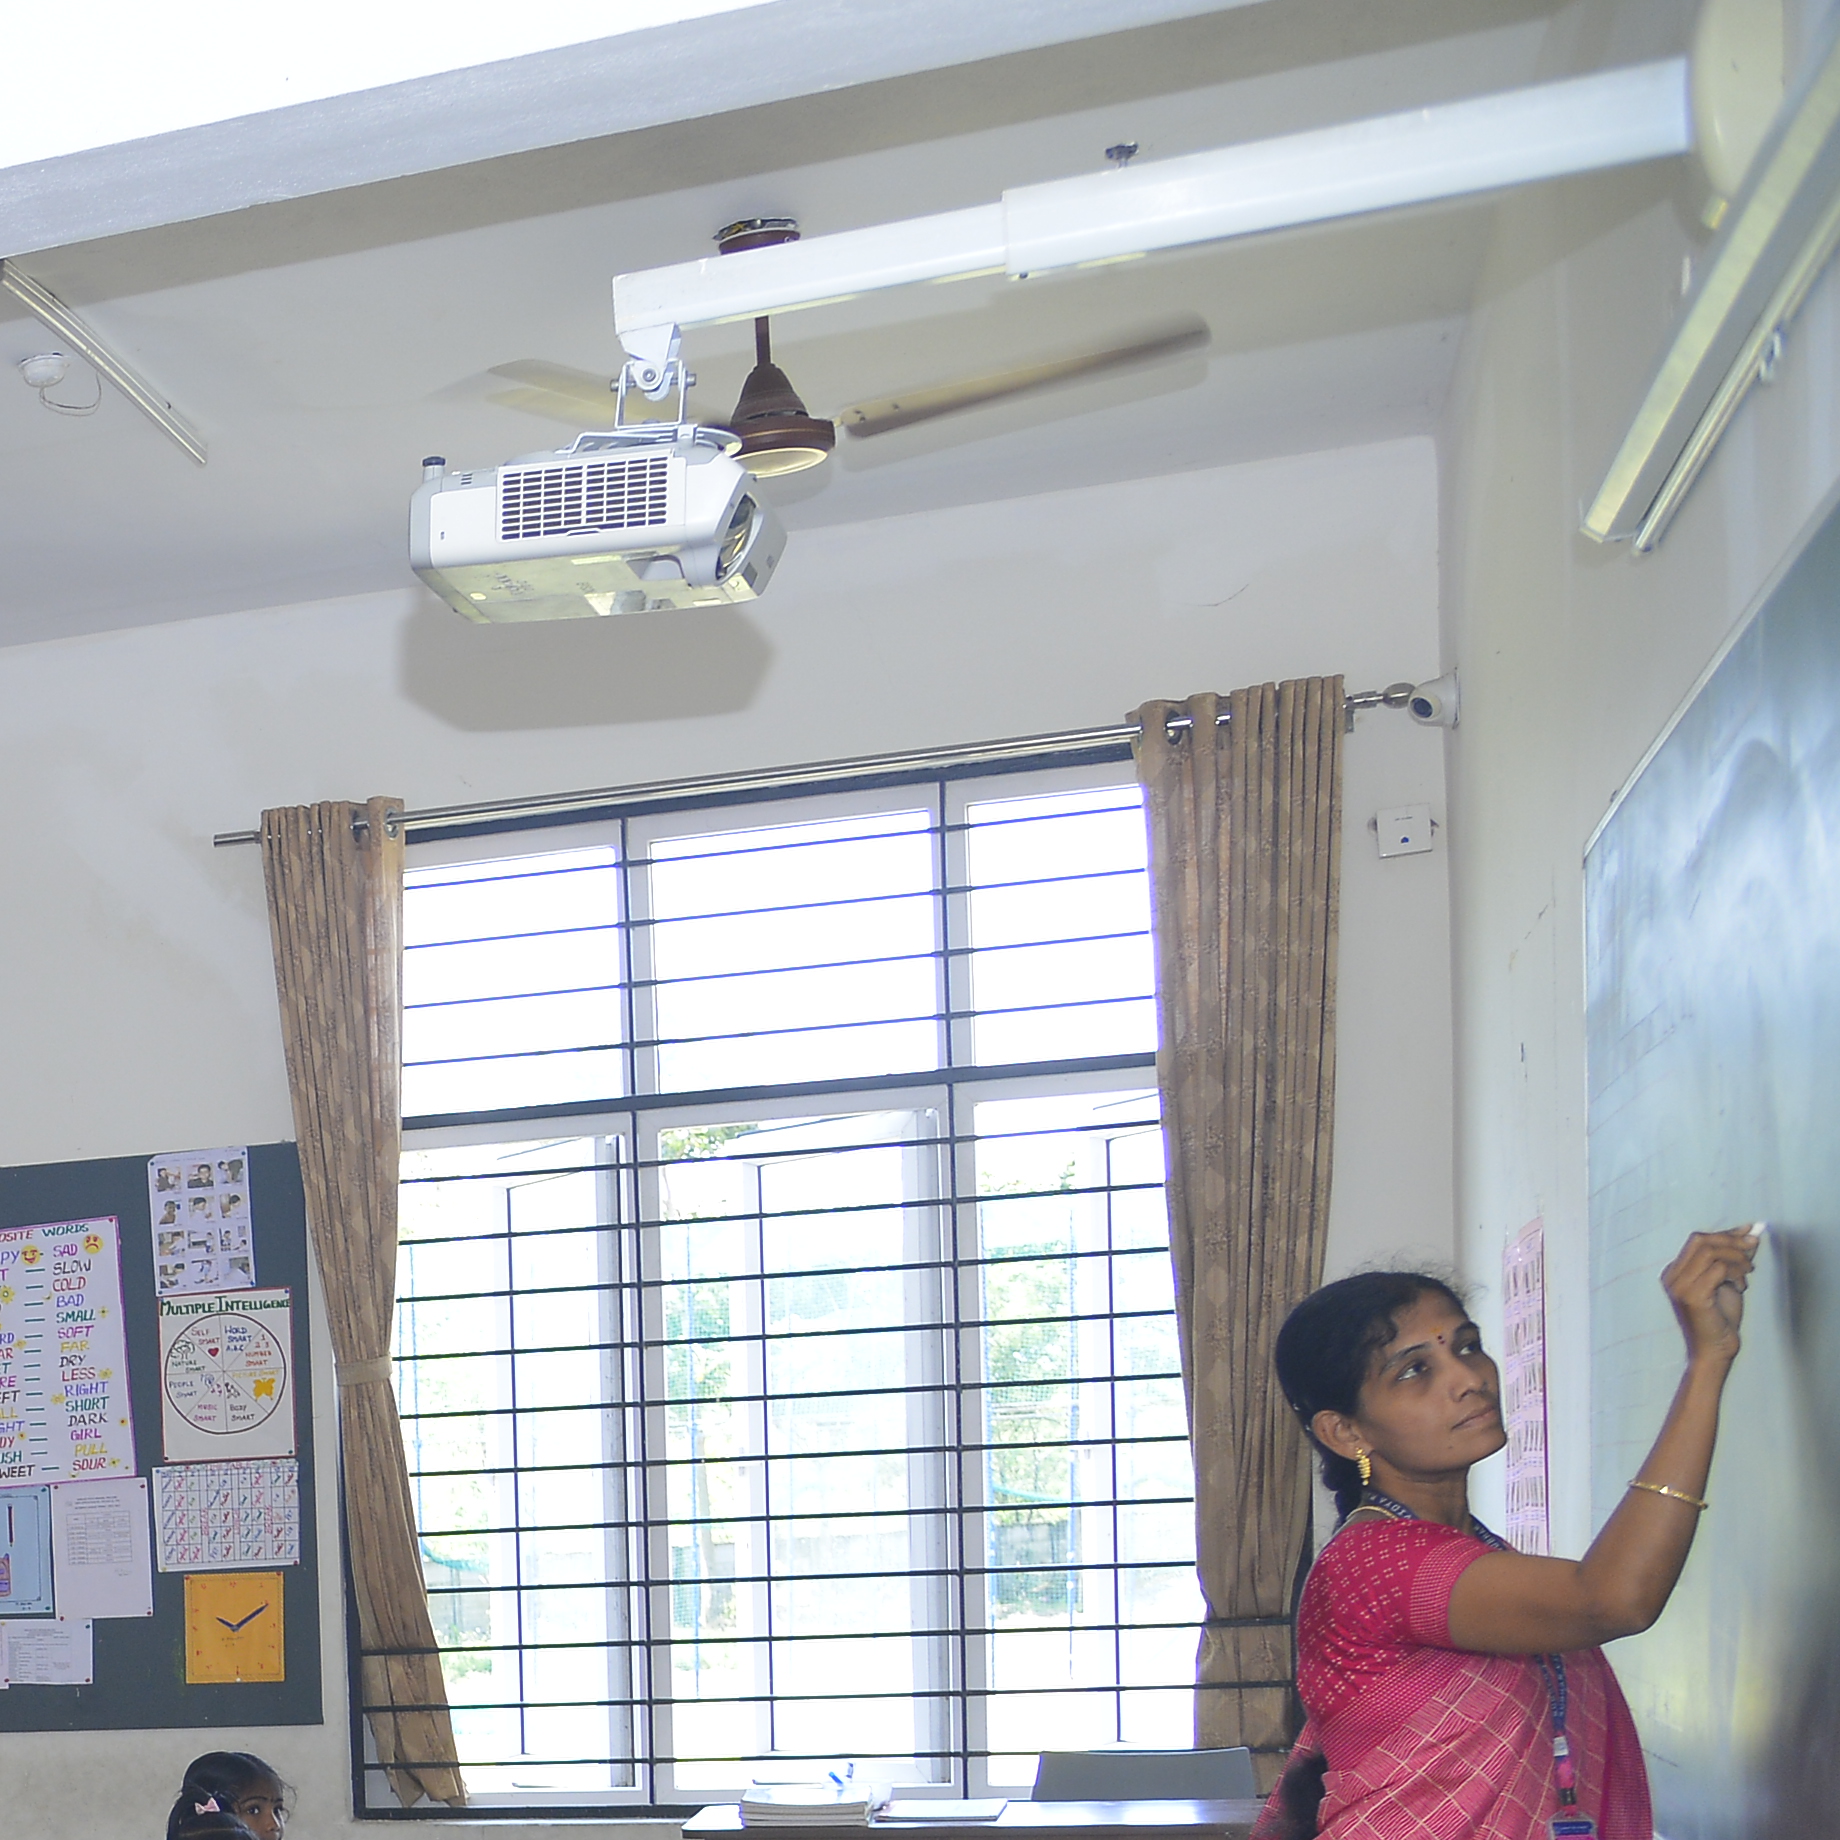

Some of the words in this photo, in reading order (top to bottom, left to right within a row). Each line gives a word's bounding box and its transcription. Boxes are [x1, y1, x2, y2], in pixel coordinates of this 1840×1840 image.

[42, 1224, 89, 1236] WORDS
[53, 1244, 78, 1257] SAD
[53, 1259, 91, 1275] SLOW
[53, 1277, 86, 1292] COLD
[56, 1294, 84, 1307] BAD
[161, 1299, 215, 1316] MULTIPLE
[56, 1310, 96, 1323] SMALL
[58, 1325, 94, 1339] SOFT
[191, 1327, 210, 1336] SELF
[225, 1326, 247, 1334] WORD
[61, 1341, 89, 1352] FAR
[59, 1355, 86, 1367] DRY
[62, 1367, 95, 1381] LESS
[65, 1381, 109, 1396] RIGHT
[65, 1396, 110, 1412] SHORT
[68, 1413, 108, 1427] DARK
[71, 1429, 102, 1441] GIRL
[75, 1444, 108, 1457] PULL
[73, 1458, 106, 1471] SOUR
